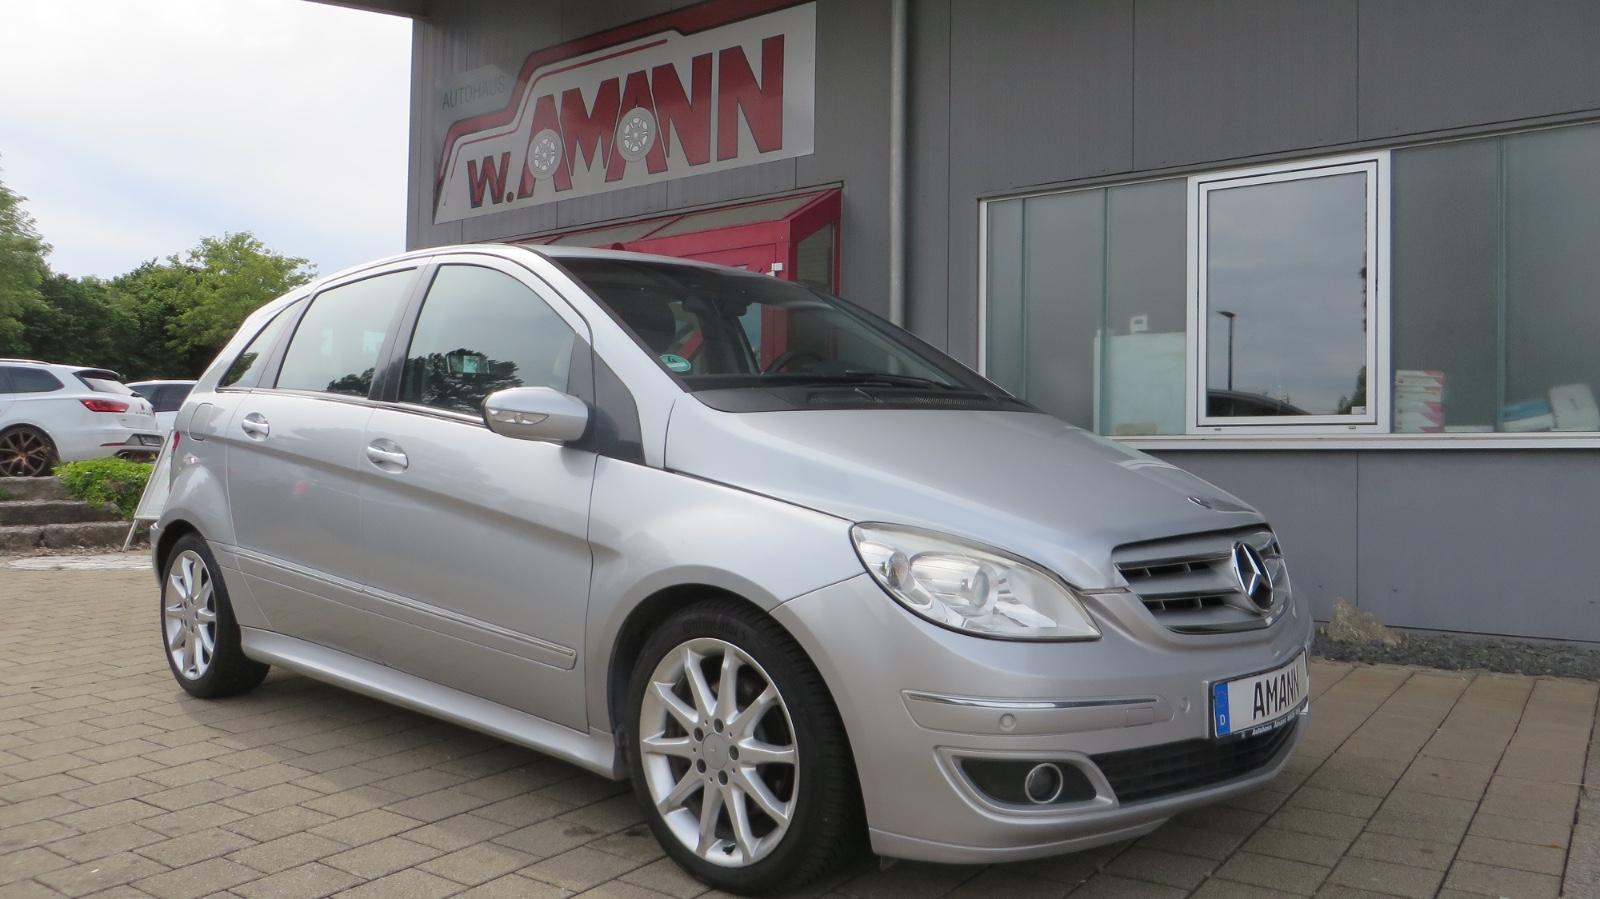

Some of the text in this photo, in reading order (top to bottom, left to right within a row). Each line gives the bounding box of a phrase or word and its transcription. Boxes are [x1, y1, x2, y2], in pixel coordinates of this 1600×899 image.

[442, 74, 505, 111] AUTOHAUS
[467, 34, 785, 209] W. AMANN
[1220, 664, 1300, 725] D AMANN
